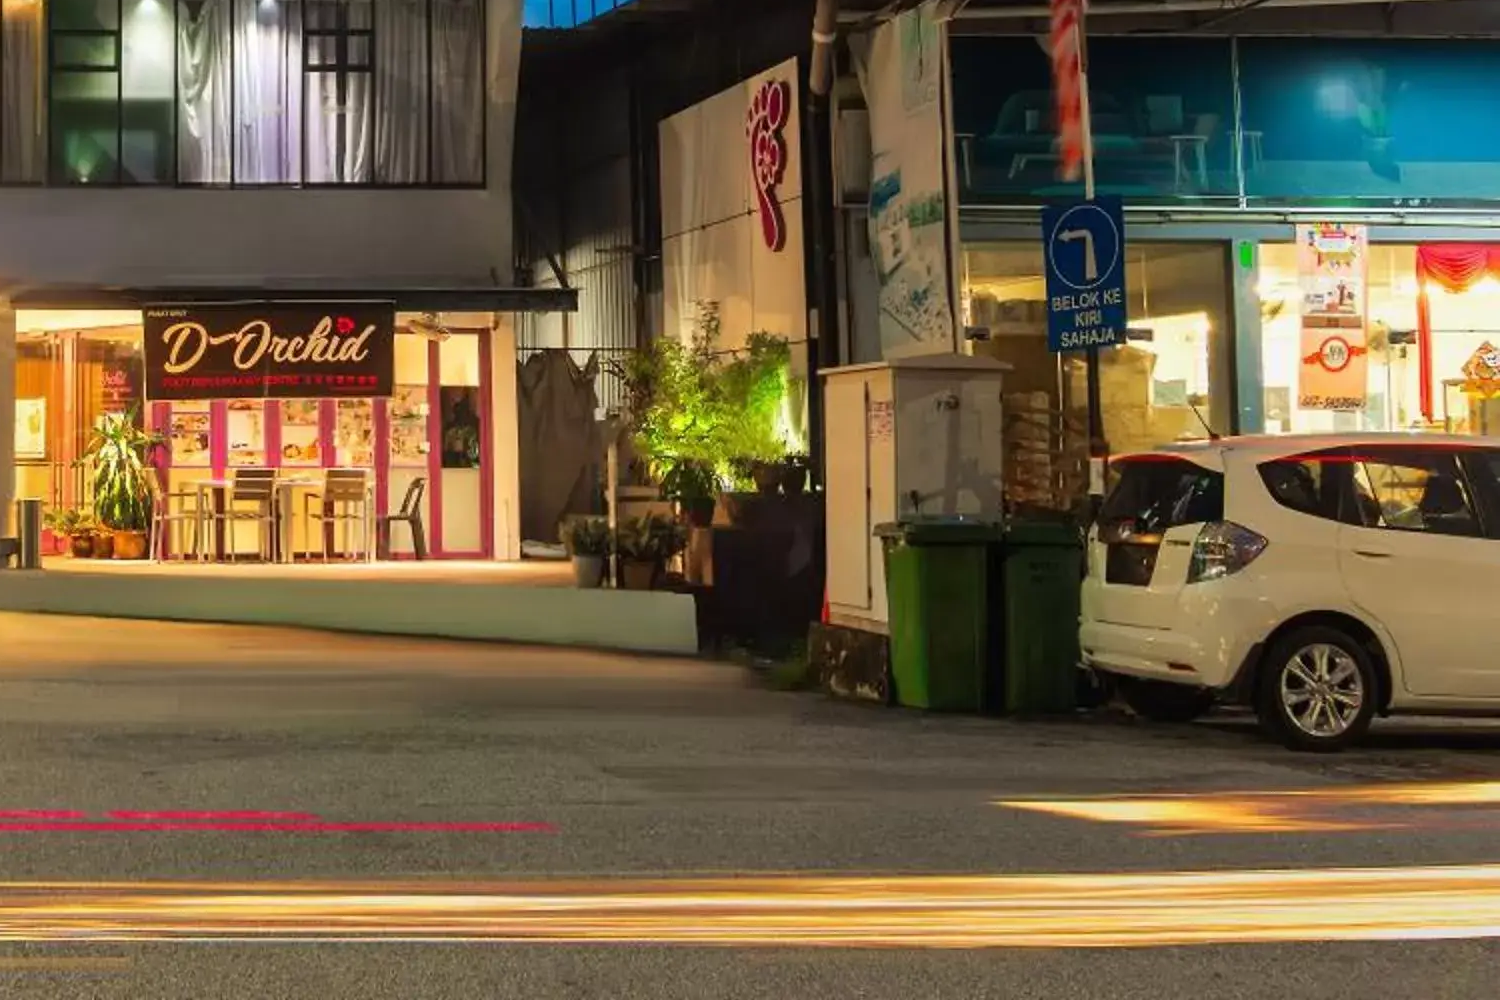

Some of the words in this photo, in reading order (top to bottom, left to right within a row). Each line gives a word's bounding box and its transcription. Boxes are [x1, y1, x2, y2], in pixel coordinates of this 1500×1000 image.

[1052, 291, 1100, 311] BELOK
[1103, 288, 1122, 304] KE
[1074, 308, 1102, 327] KIRI
[162, 315, 376, 374] D-Orchid
[1061, 327, 1114, 347] SAHAJA
